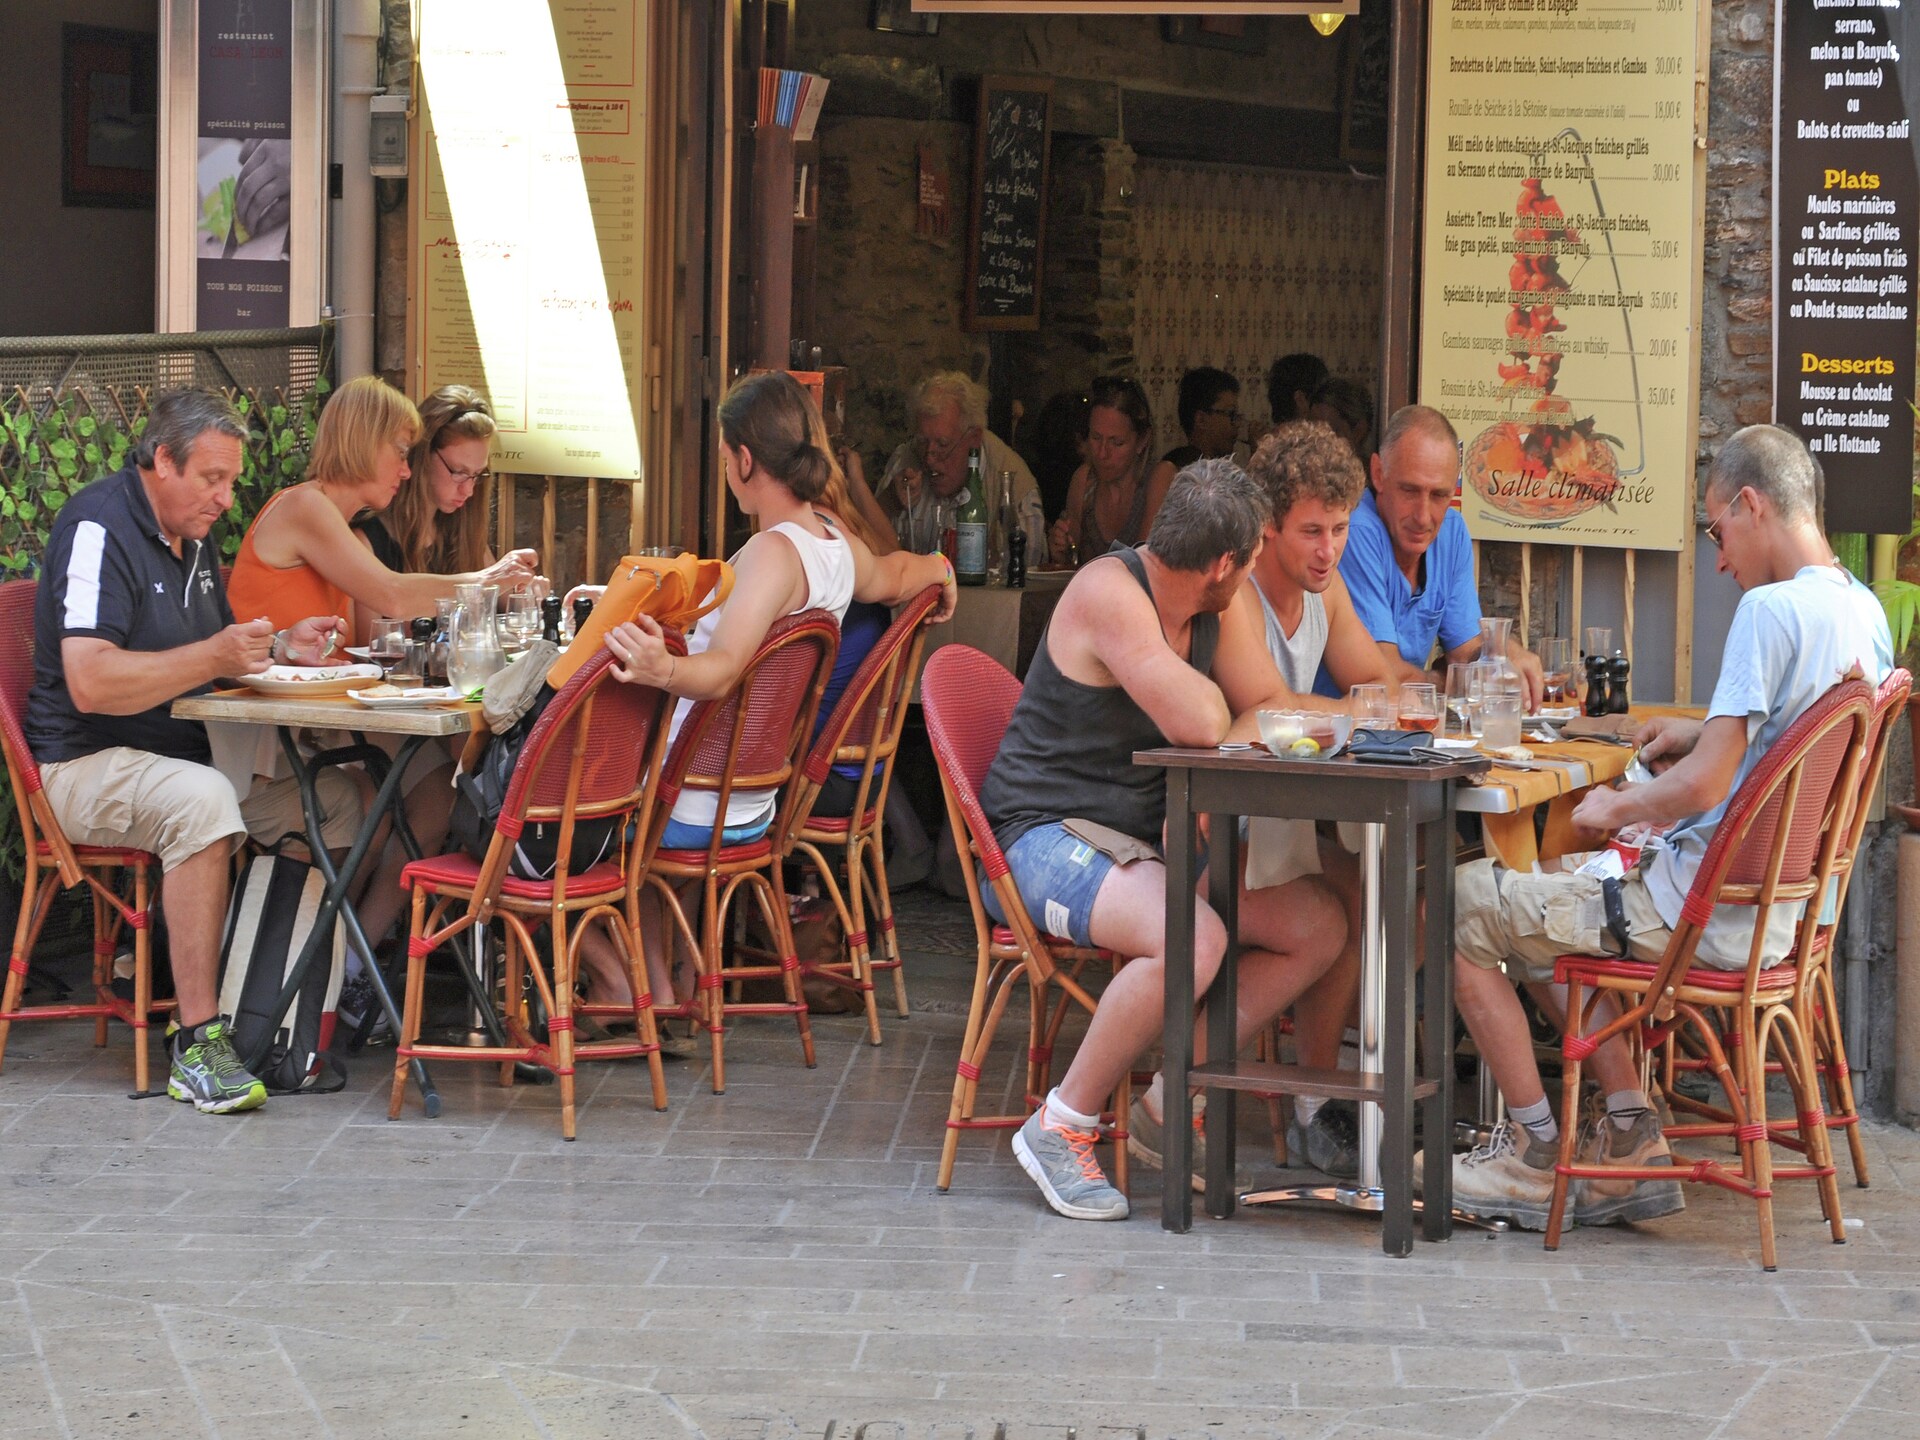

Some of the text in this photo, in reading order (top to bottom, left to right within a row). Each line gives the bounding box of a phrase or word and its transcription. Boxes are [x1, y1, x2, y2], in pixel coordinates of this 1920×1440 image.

[1537, 0, 1545, 11] en
[1835, 19, 1876, 35] serrano,
[1810, 40, 1900, 63] melon au Banyuls,
[1450, 56, 1484, 73] Brochettes
[1486, 56, 1494, 73] de
[1495, 56, 1512, 73] Lotte
[1540, 56, 1584, 79] Saint-Jacques
[1613, 58, 1621, 74] et
[1622, 57, 1647, 74] Gambas
[1655, 56, 1683, 77] 30,00 €
[1825, 67, 1883, 90] pan tomate)
[1448, 98, 1473, 117] Rouille
[1474, 99, 1482, 117] de
[1654, 101, 1682, 122] 18,00 €
[1847, 98, 1860, 112] ou
[207, 120, 286, 130] spécialité poisson
[1797, 119, 1829, 139] Bulots
[1830, 121, 1841, 139] et
[1842, 121, 1885, 139] crevettes
[1448, 135, 1464, 152] Méli
[1465, 135, 1483, 152] mélo
[1485, 135, 1494, 153] de
[1447, 164, 1456, 176] au
[1458, 161, 1486, 177] Serrano
[1488, 162, 1496, 178] et
[1497, 161, 1528, 179] chorizo,
[1554, 162, 1563, 179] de
[1565, 162, 1595, 184] Banyuls
[1652, 164, 1680, 184] 30,00 €
[1824, 169, 1881, 189] Plats
[1807, 194, 1896, 215] Moules marinières
[1445, 210, 1475, 227] Assiette
[1477, 211, 1497, 228] Terre
[1499, 211, 1513, 228] Mer
[1566, 215, 1574, 229] et
[1801, 220, 1900, 244] ou Sardines grillées
[1445, 235, 1459, 251] foie
[1460, 240, 1476, 257] gras
[1561, 238, 1590, 260] Banyuls
[1651, 240, 1679, 260] 35,00 €
[1793, 247, 1908, 270] ou Filet de poisson frais
[206, 282, 283, 293] TOUS NOS POISSONS
[1791, 272, 1908, 297] ou Saucisse catalane grillée
[1476, 285, 1485, 303] de
[1588, 294, 1597, 307] au
[1650, 291, 1672, 311] 35,00
[236, 307, 252, 317] bar
[1790, 299, 1908, 320] ou Poulet sauce catalane
[1442, 331, 1471, 350] Gambas
[1584, 336, 1609, 360] whisky
[1649, 339, 1677, 360] 20,00 €
[1801, 352, 1895, 375] Desserts
[1441, 379, 1467, 397] Rossini
[1467, 380, 1476, 398] de
[1647, 387, 1676, 408] 35,00 €
[1800, 380, 1893, 402] Mousse au chocolat
[1462, 404, 1471, 420] de
[1802, 407, 1890, 428] ou Crème catalane
[1809, 433, 1881, 454] ou Ile flottante
[504, 450, 525, 460] TTC
[1488, 469, 1656, 504] Salle climatisée
[1612, 526, 1640, 535] TTC
